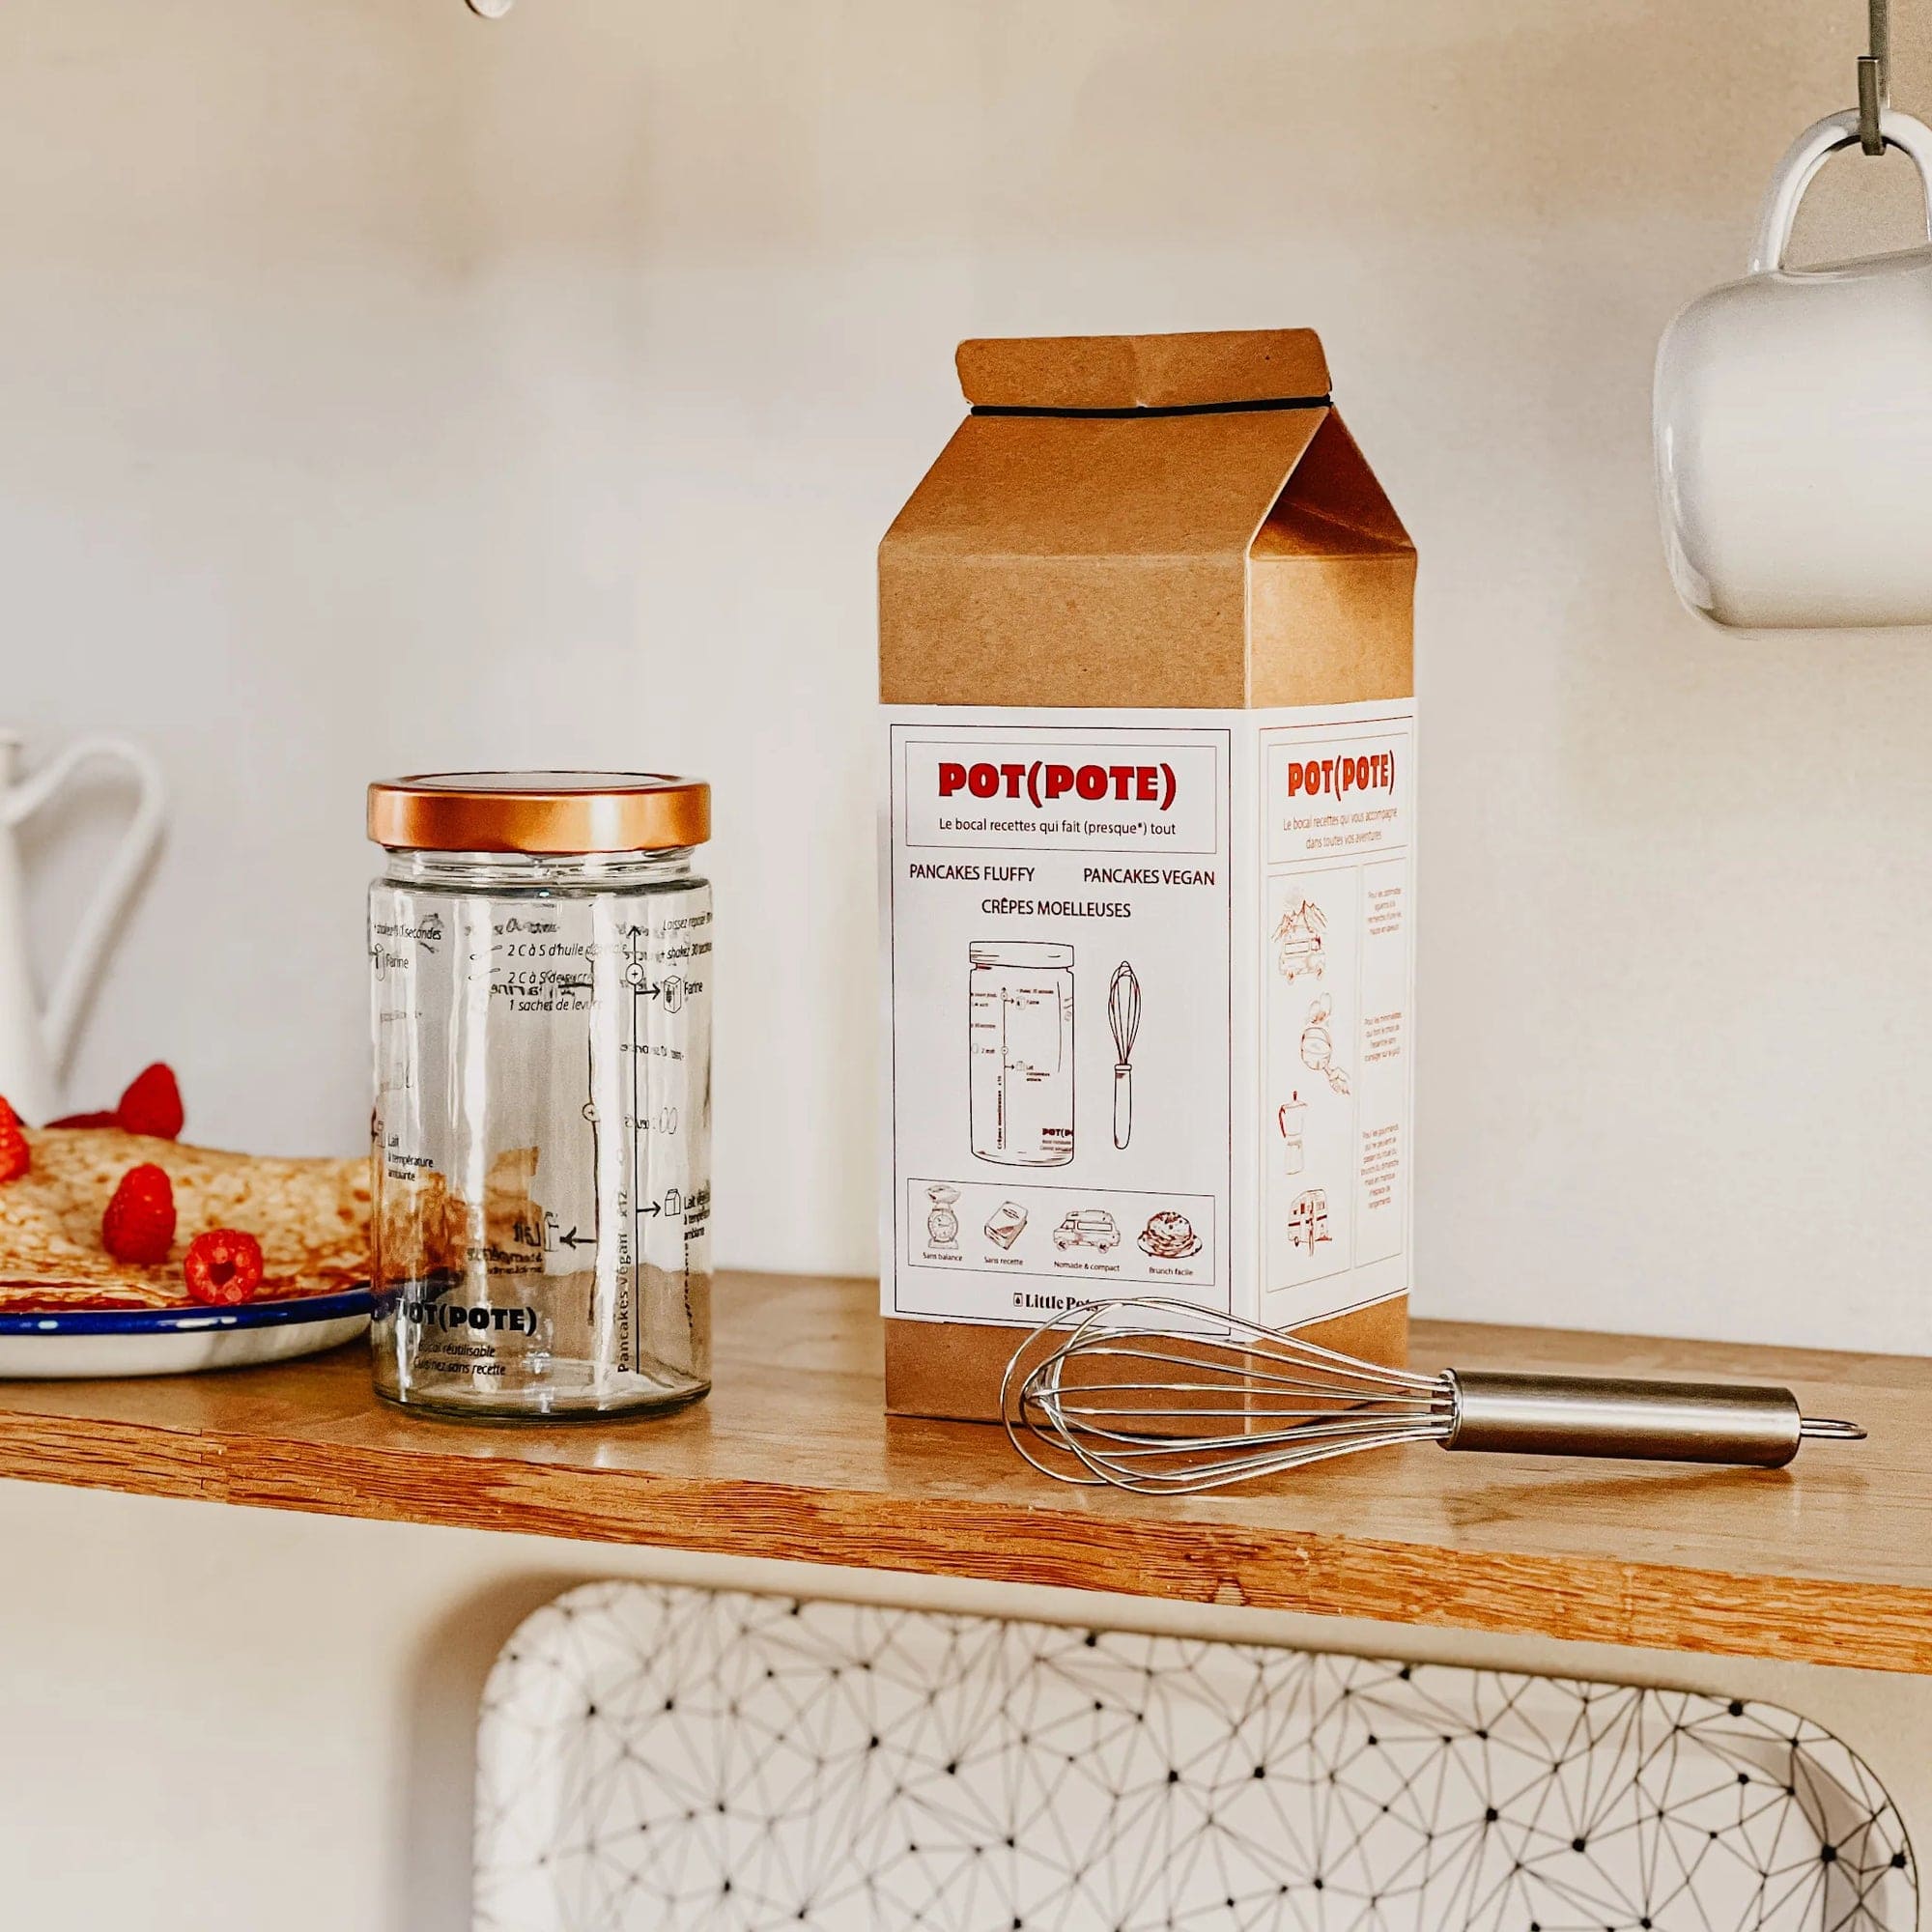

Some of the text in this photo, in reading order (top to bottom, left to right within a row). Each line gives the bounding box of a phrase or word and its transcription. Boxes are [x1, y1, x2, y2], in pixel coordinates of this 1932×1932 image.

[1288, 750, 1394, 802] POT(POTE)
[938, 760, 1177, 810] POT(POTE)
[939, 818, 952, 831] Le
[954, 817, 986, 832] bocal
[990, 820, 1037, 834] recettes
[1039, 820, 1059, 838] qui
[1062, 819, 1081, 834] fait
[1150, 823, 1176, 836] tout
[1283, 818, 1292, 831] Le
[1293, 814, 1312, 830] bocal
[1314, 814, 1339, 828] recettes
[910, 864, 1036, 882] PANCAKES FLUFFY
[1084, 867, 1215, 886] PANCAKES VEGAN
[981, 897, 1131, 918] CRÊPES MOELLEUSES
[507, 944, 515, 956] 2
[518, 944, 526, 956] C
[528, 943, 536, 956] à
[539, 944, 546, 956] S
[548, 943, 583, 956] d'huile
[507, 972, 515, 983] 2
[518, 972, 526, 983] C
[528, 970, 536, 983] à
[509, 999, 514, 1010] 1
[518, 999, 554, 1011] sachet
[555, 999, 569, 1010] de
[938, 1253, 963, 1262] balance
[1054, 1261, 1083, 1270] Nomade
[1090, 1263, 1121, 1272] compact
[1149, 1266, 1194, 1276] Brunch facile
[1025, 1293, 1064, 1310] Little
[394, 1301, 537, 1337] OT(POTE)
[616, 1291, 630, 1373] Pancakes
[447, 1361, 469, 1375] sans
[471, 1363, 506, 1376] recette
